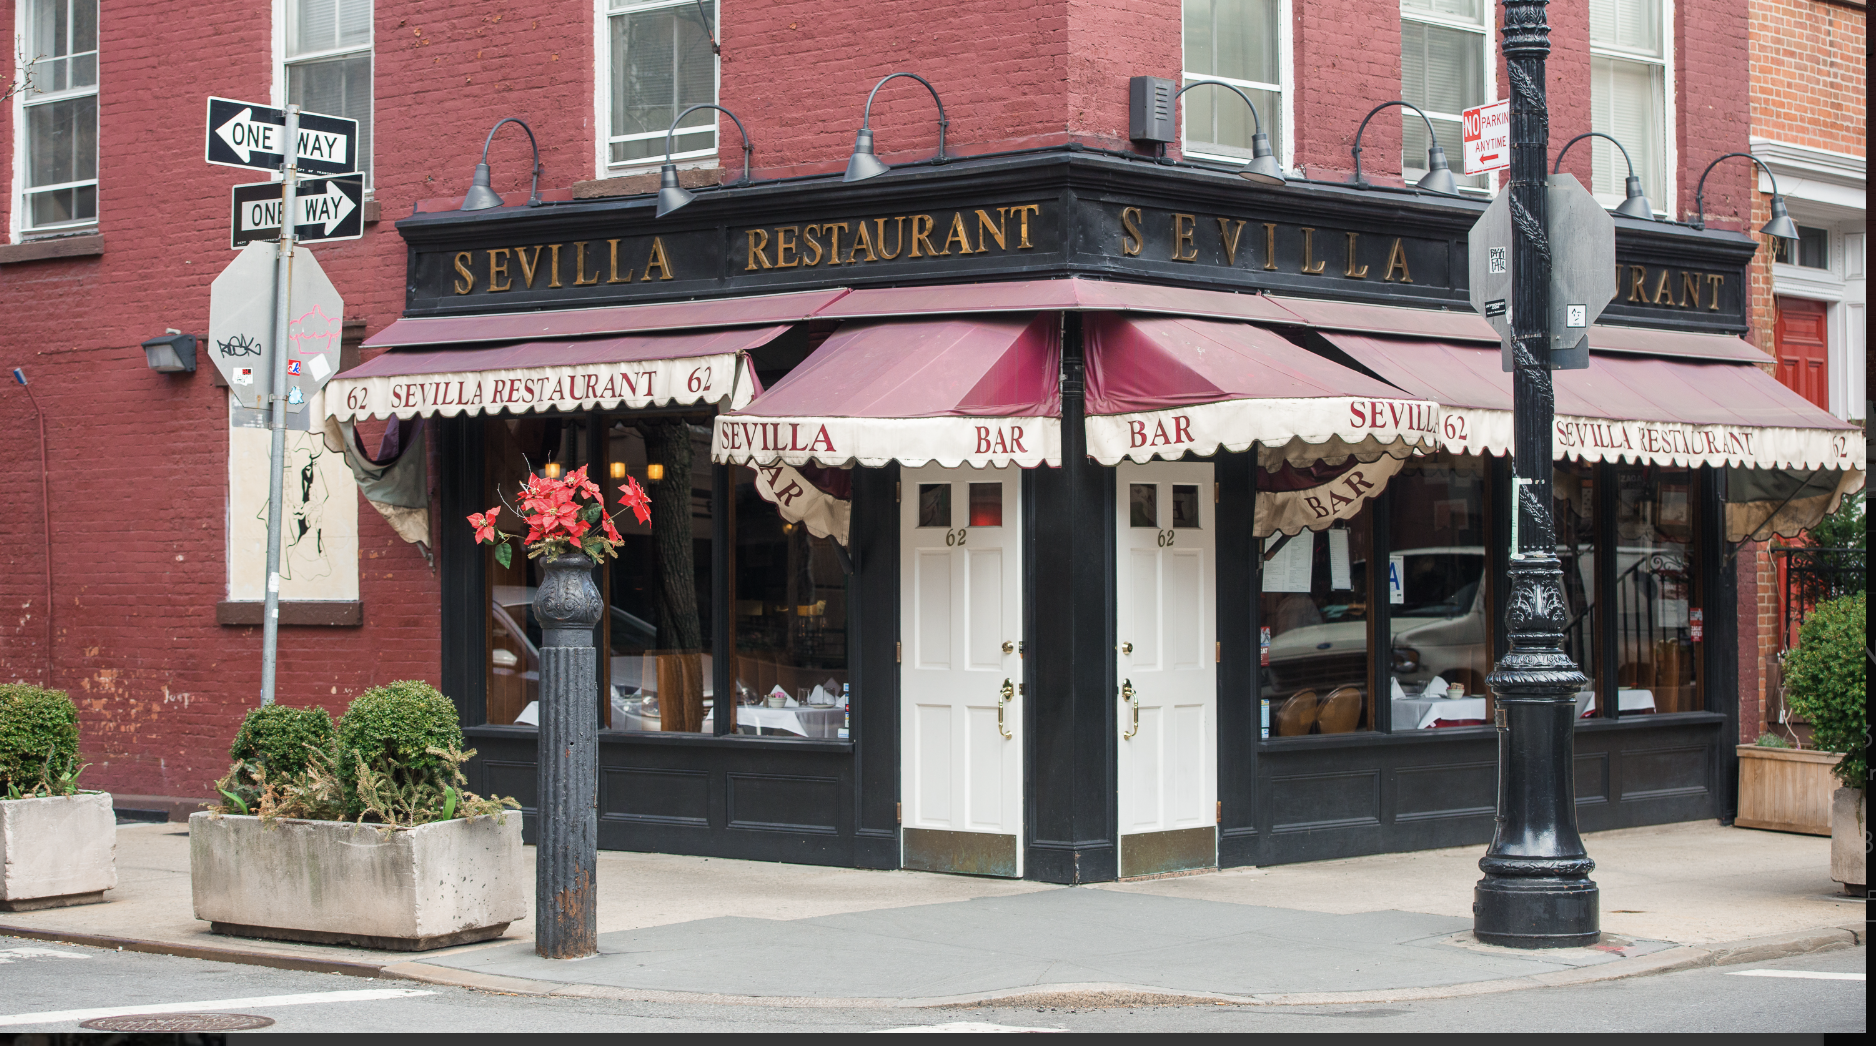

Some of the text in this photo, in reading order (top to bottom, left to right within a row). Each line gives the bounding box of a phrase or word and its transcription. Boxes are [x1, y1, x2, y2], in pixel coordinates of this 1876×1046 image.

[232, 122, 338, 158] ONE WAY
[1464, 111, 1509, 138] NO PARKIN
[1475, 135, 1507, 153] ANYTIME
[305, 196, 343, 222] WAY
[454, 204, 1040, 295] SEVILLA RESTAURANT
[1121, 206, 1414, 283] SEVILLA
[346, 365, 712, 411] 62 SEVILLA RESTAURANT 62
[721, 421, 1028, 455] SEVILLA BAR
[1128, 415, 1196, 449] BAR
[1444, 414, 1848, 458] 62 SEVILLA RESTAURANT 62
[759, 466, 804, 507] AR
[1303, 470, 1375, 520] BAR
[946, 528, 967, 547] 62
[1157, 529, 1175, 548] 62
[1389, 561, 1401, 591] A
